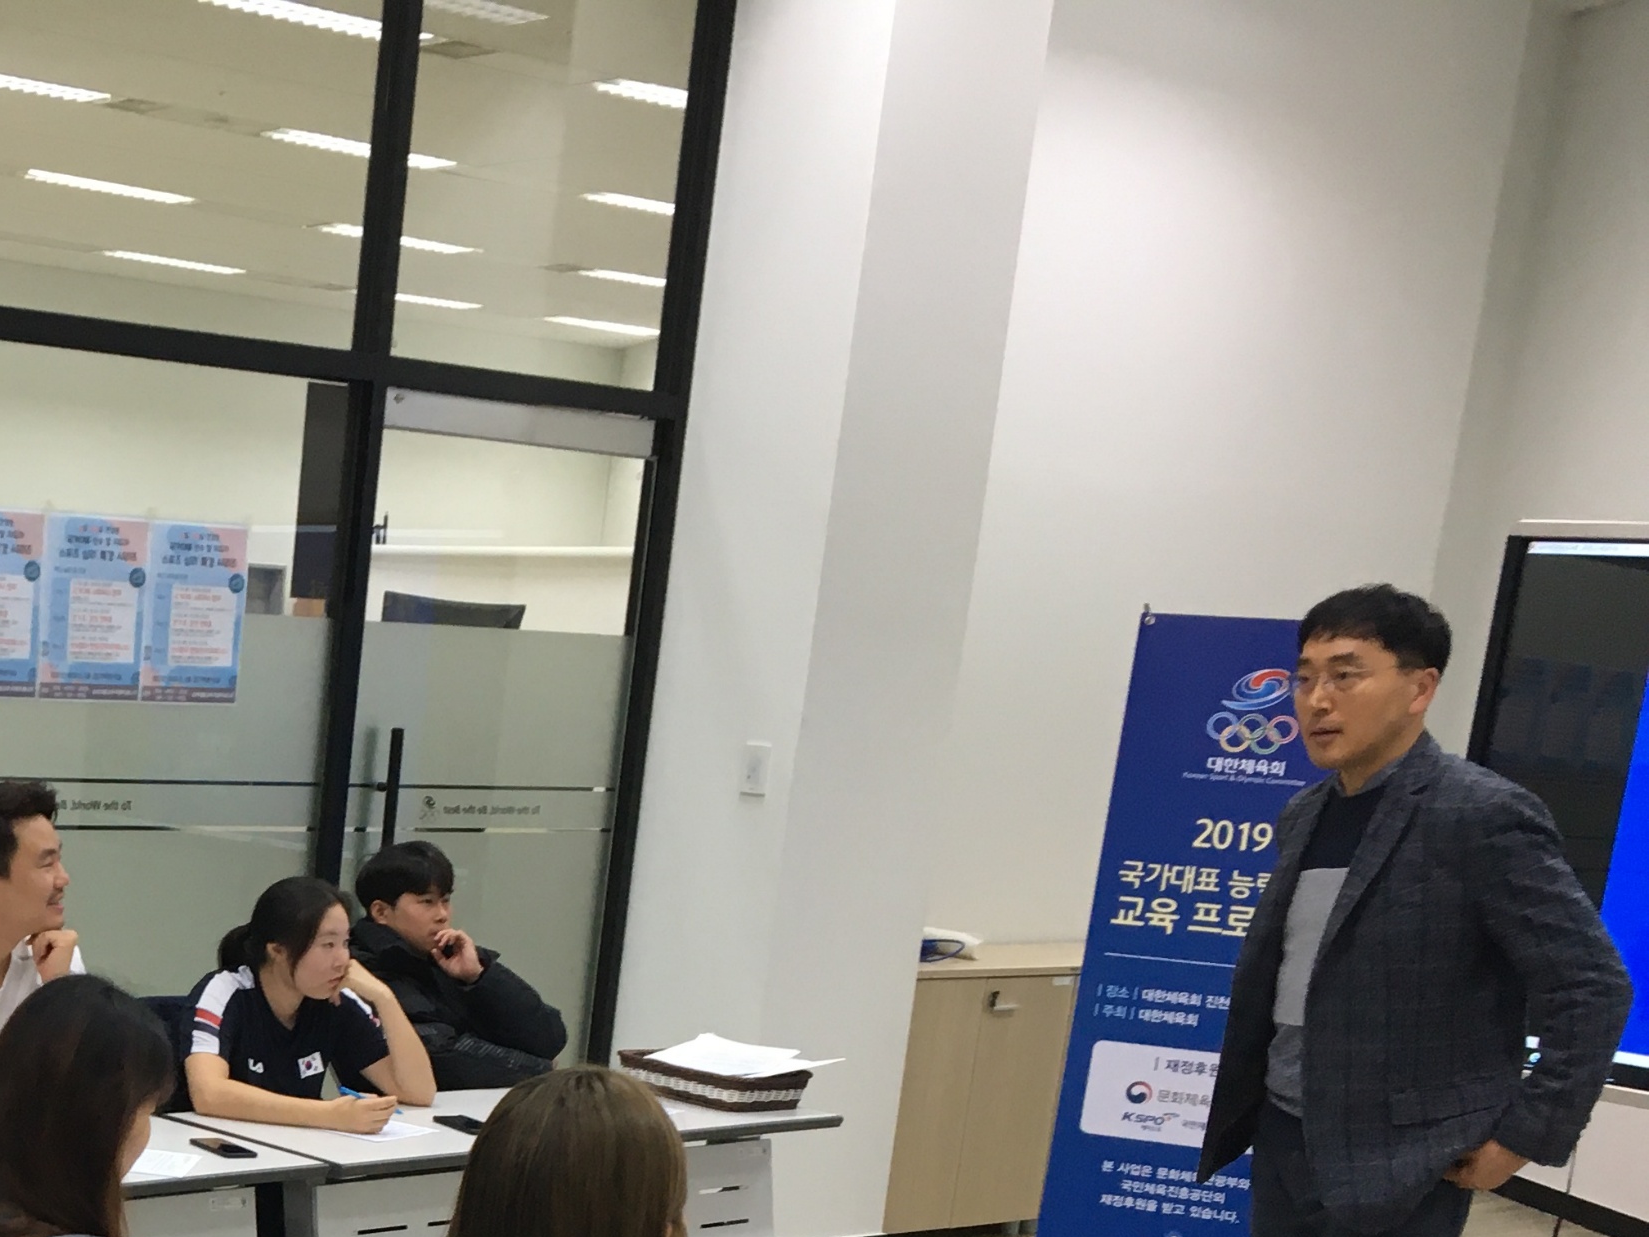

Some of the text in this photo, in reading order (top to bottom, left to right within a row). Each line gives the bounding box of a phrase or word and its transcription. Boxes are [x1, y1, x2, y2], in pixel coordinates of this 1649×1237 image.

[1206, 756, 1287, 777] 대한체육회
[1191, 817, 1273, 852] 2019
[1118, 860, 1221, 894] 국가대표
[1109, 896, 1181, 935] 교육
[1141, 988, 1203, 1007] 대한체육회
[1138, 1008, 1200, 1028] 대한체육회
[1121, 1111, 1165, 1126] KSPO
[1117, 1162, 1153, 1178] 사업은
